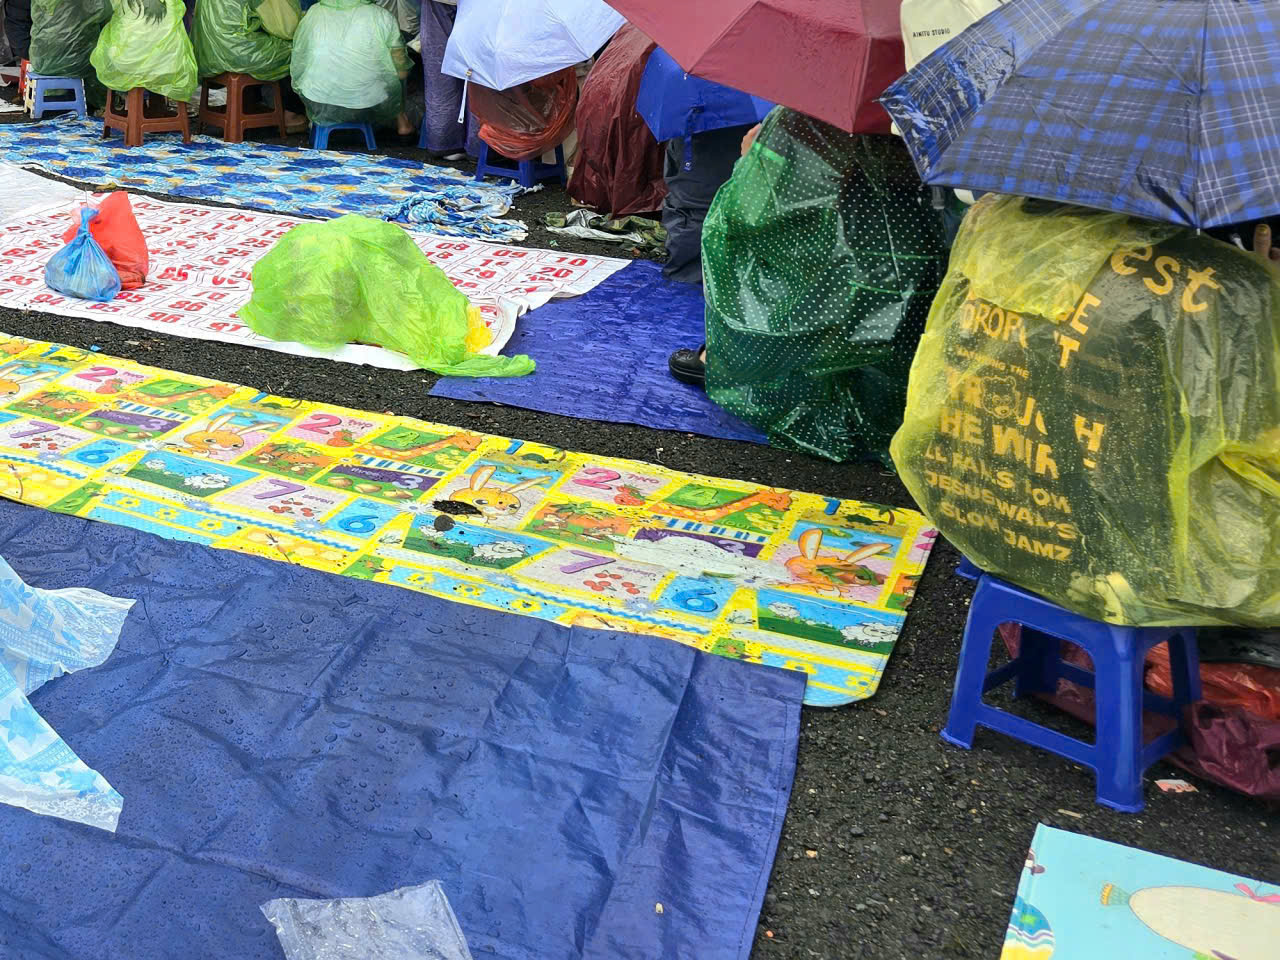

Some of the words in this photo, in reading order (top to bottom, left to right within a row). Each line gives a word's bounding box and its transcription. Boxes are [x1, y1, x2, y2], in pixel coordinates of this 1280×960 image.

[162, 216, 192, 225] 13
[179, 208, 210, 217] 03
[238, 238, 273, 248] 25
[435, 242, 470, 251] 08
[555, 257, 588, 266] 10
[539, 267, 574, 278] 20
[168, 300, 208, 311] 86
[147, 311, 185, 323] 96
[75, 366, 118, 383] 2
[10, 420, 61, 439] 7
[139, 419, 168, 431] 3
[297, 413, 342, 435] 2
[348, 419, 373, 429] two
[76, 448, 116, 464] 6
[392, 474, 424, 490] 3
[572, 467, 621, 491] 2
[627, 474, 660, 484] two
[254, 478, 306, 500] 7
[338, 514, 379, 534] 6
[1003, 528, 1072, 561] JAMZ
[560, 550, 617, 575] 7
[671, 588, 719, 613] 6
